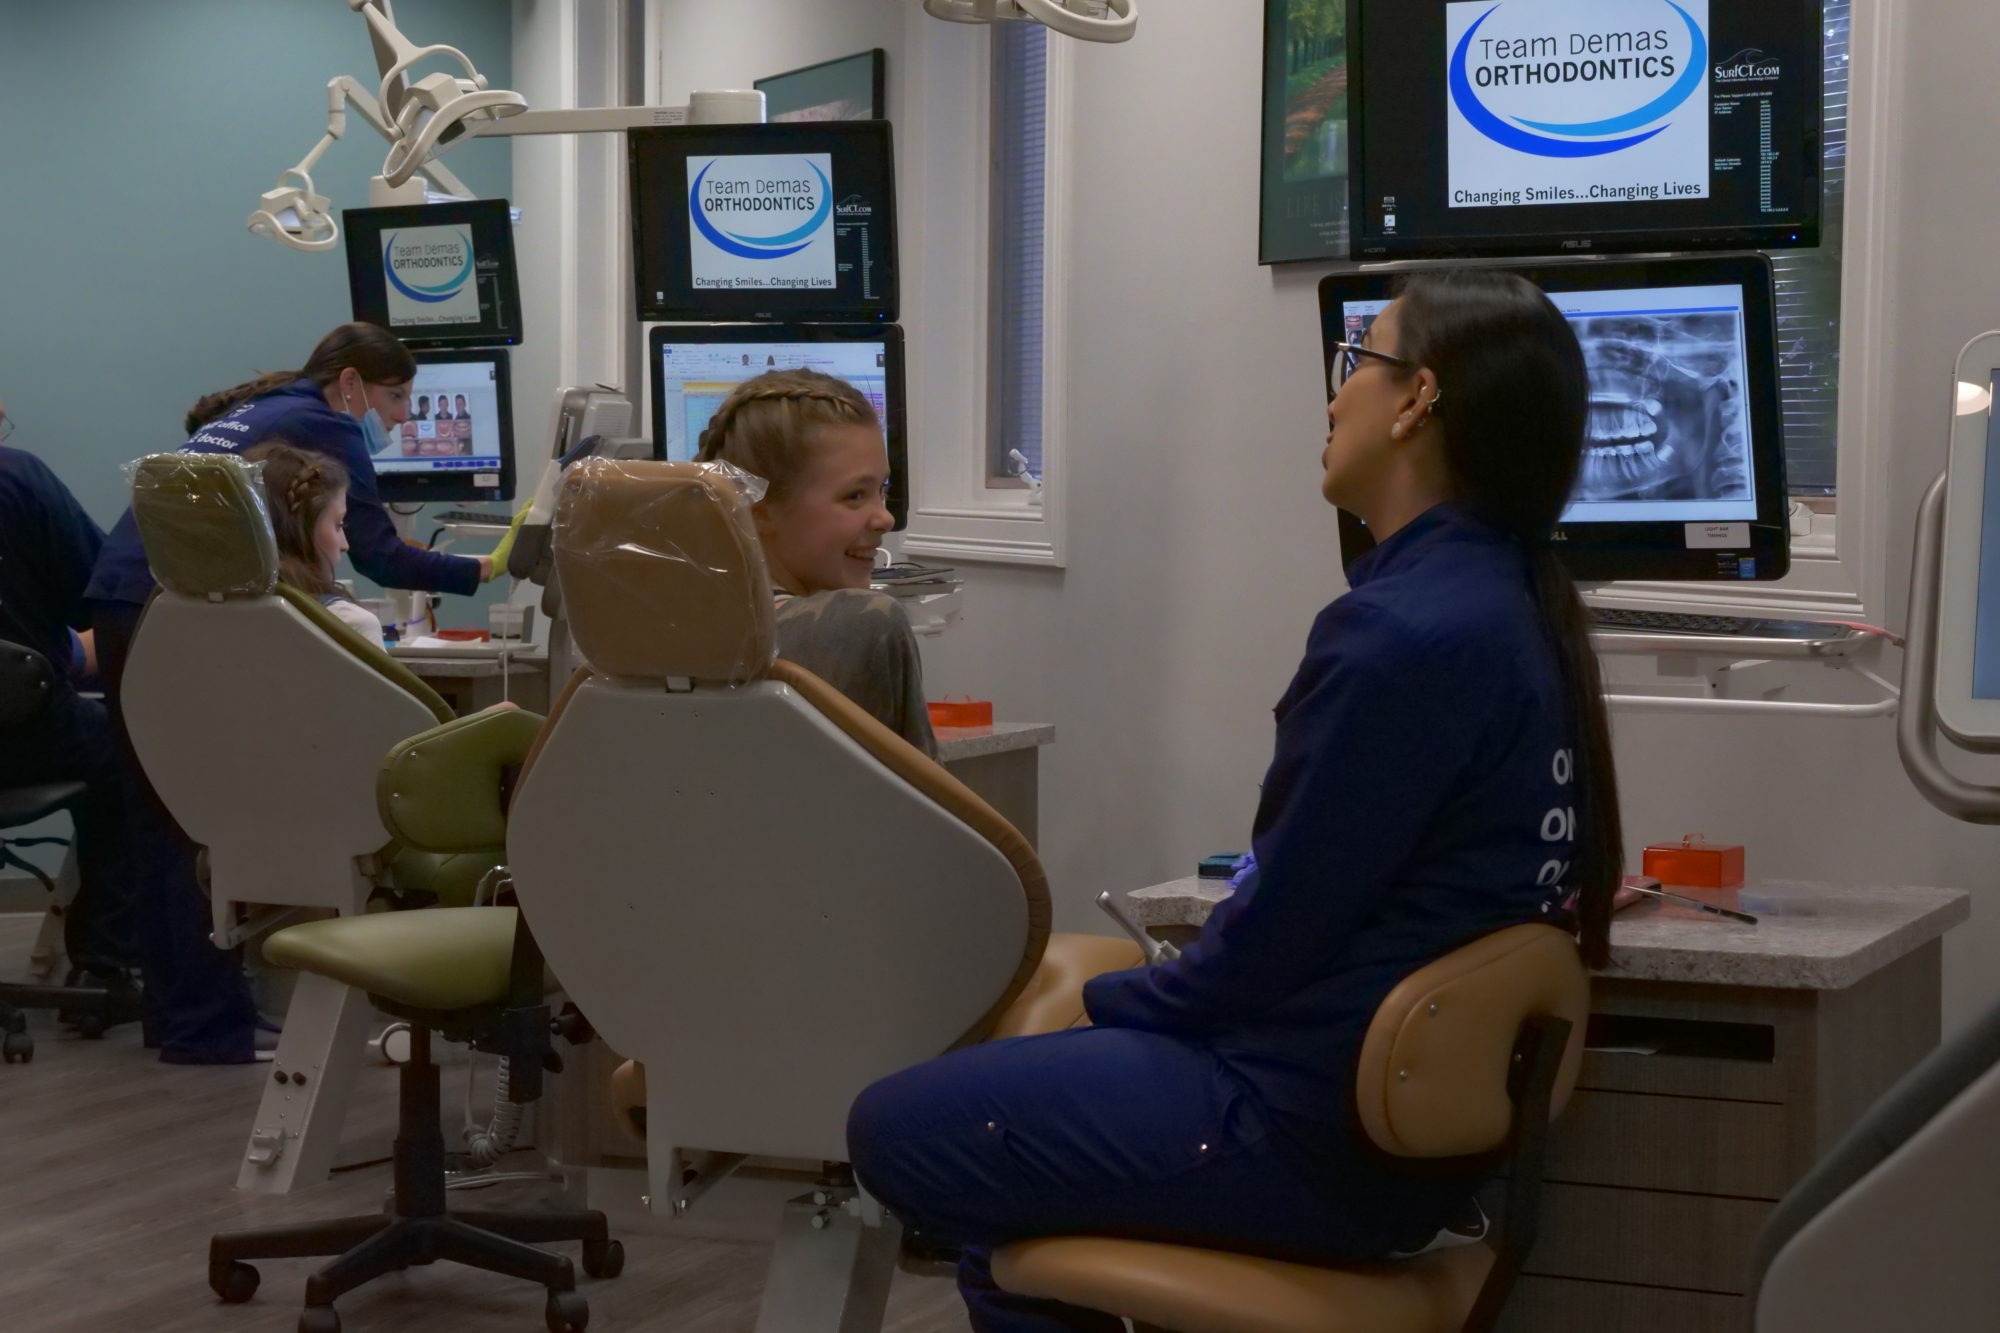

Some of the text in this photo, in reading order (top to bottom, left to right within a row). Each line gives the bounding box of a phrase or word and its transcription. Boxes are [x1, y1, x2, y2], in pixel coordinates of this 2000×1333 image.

[1479, 29, 1668, 60] Team Demas
[1475, 55, 1675, 87] ORTHODONTICS
[706, 179, 811, 194] Team Demas
[1454, 188, 1521, 204] Changing
[1663, 181, 1701, 196] Lives
[704, 196, 815, 212] ORTHODONTICS
[393, 243, 460, 257] Team Demas
[1561, 239, 1592, 249] ASUS
[393, 255, 464, 270] ORTHODONTICS
[695, 276, 733, 289] Changing
[811, 276, 832, 287] Lives
[217, 421, 250, 432] office
[197, 432, 239, 449] doctor
